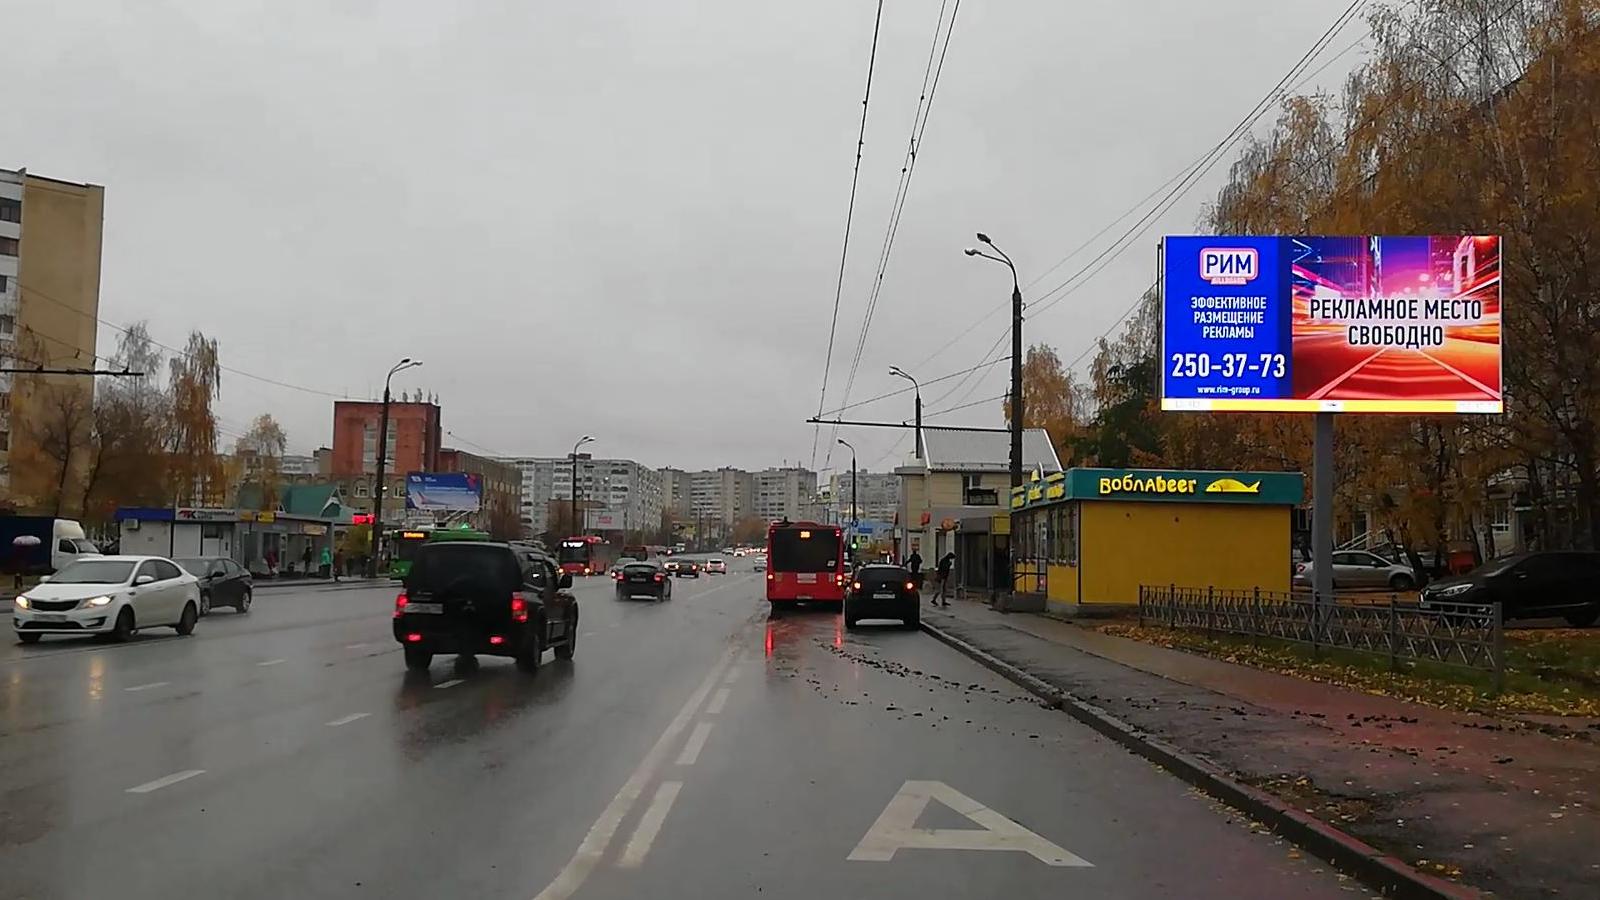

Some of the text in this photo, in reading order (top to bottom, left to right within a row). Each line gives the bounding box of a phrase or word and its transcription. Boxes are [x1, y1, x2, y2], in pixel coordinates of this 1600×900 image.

[1206, 254, 1252, 274] РИМ
[1190, 296, 1267, 310] ЭФФЕКТИВНОЕ
[1310, 299, 1482, 320] РЕКЛАМНОЕ МЕСТО
[1193, 311, 1264, 325] РАЗМЕЩЕНИЕ
[1202, 326, 1254, 339] РЕКЛАМЫ
[1348, 325, 1443, 349] СВОБОДНО
[1171, 353, 1286, 378] 250-37-73
[1196, 385, 1261, 395] www.rim-group.ru
